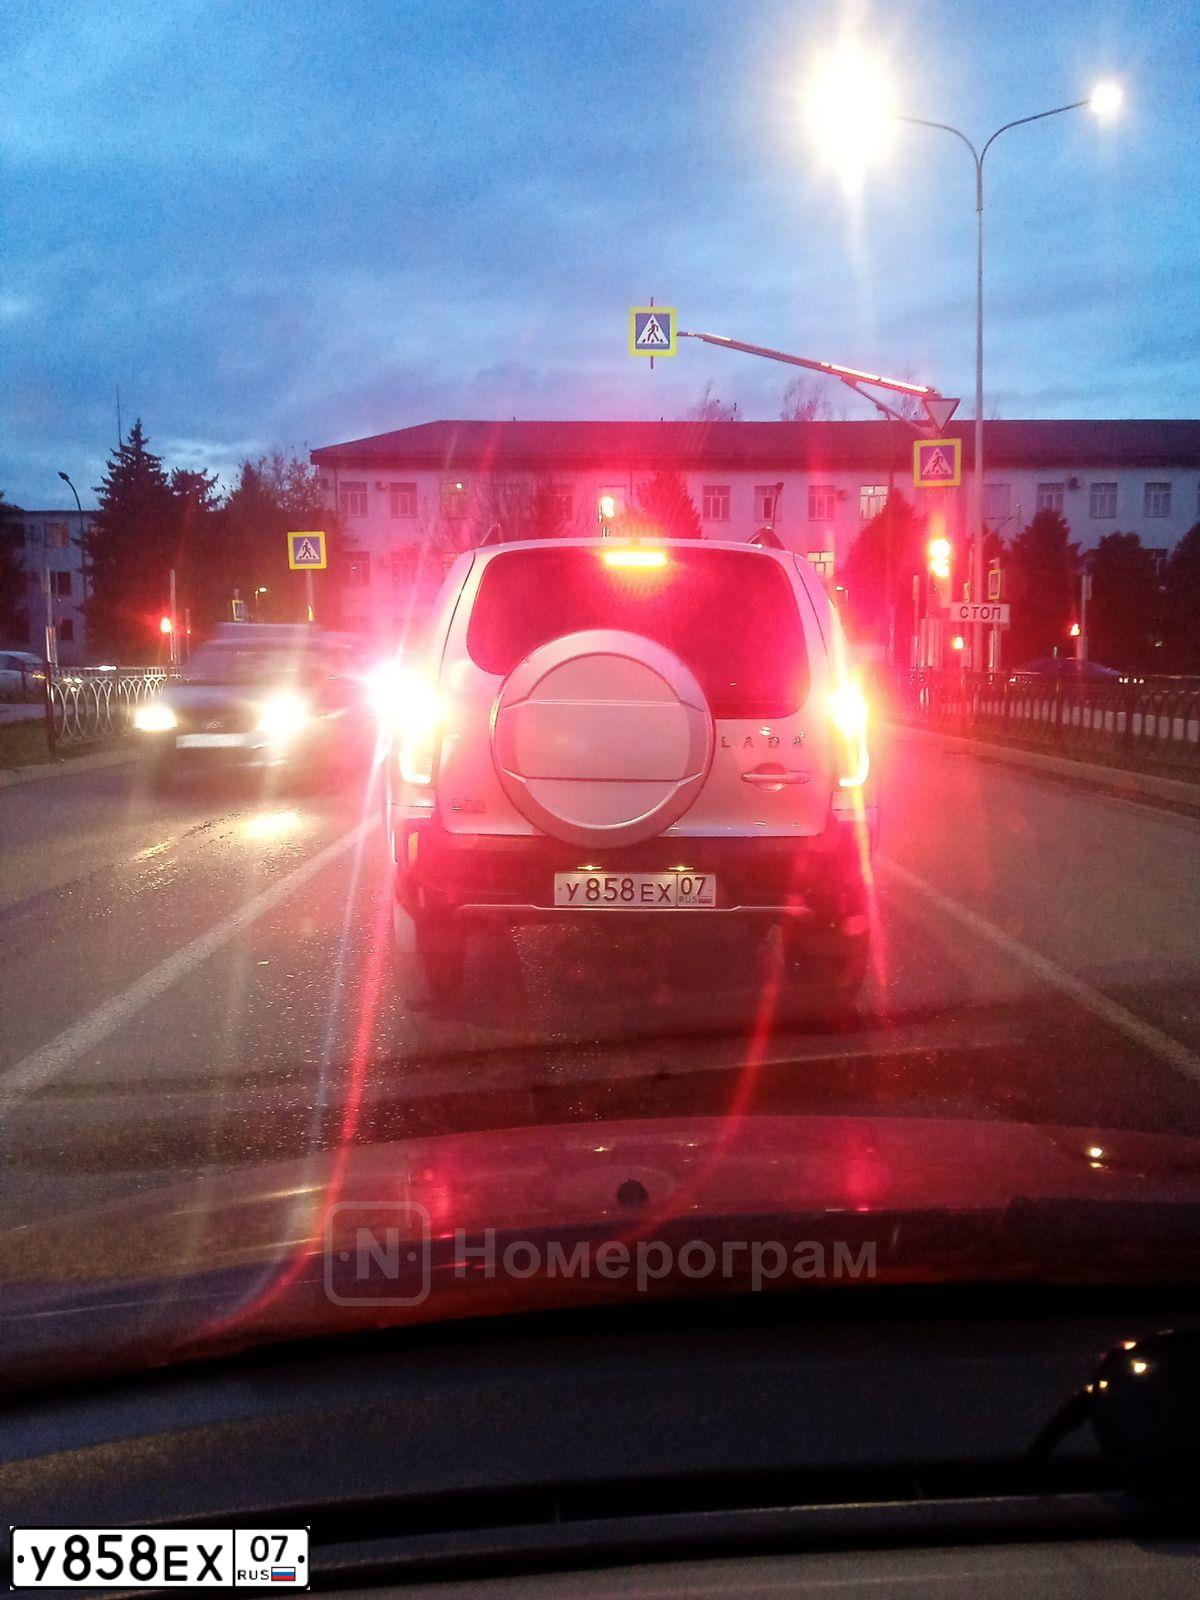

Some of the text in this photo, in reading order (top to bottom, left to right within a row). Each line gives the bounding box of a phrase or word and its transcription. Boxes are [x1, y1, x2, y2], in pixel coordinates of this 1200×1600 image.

[960, 606, 1001, 619] СТОП
[566, 877, 706, 902] У858ЕХ 07
[679, 896, 697, 904] RUS
